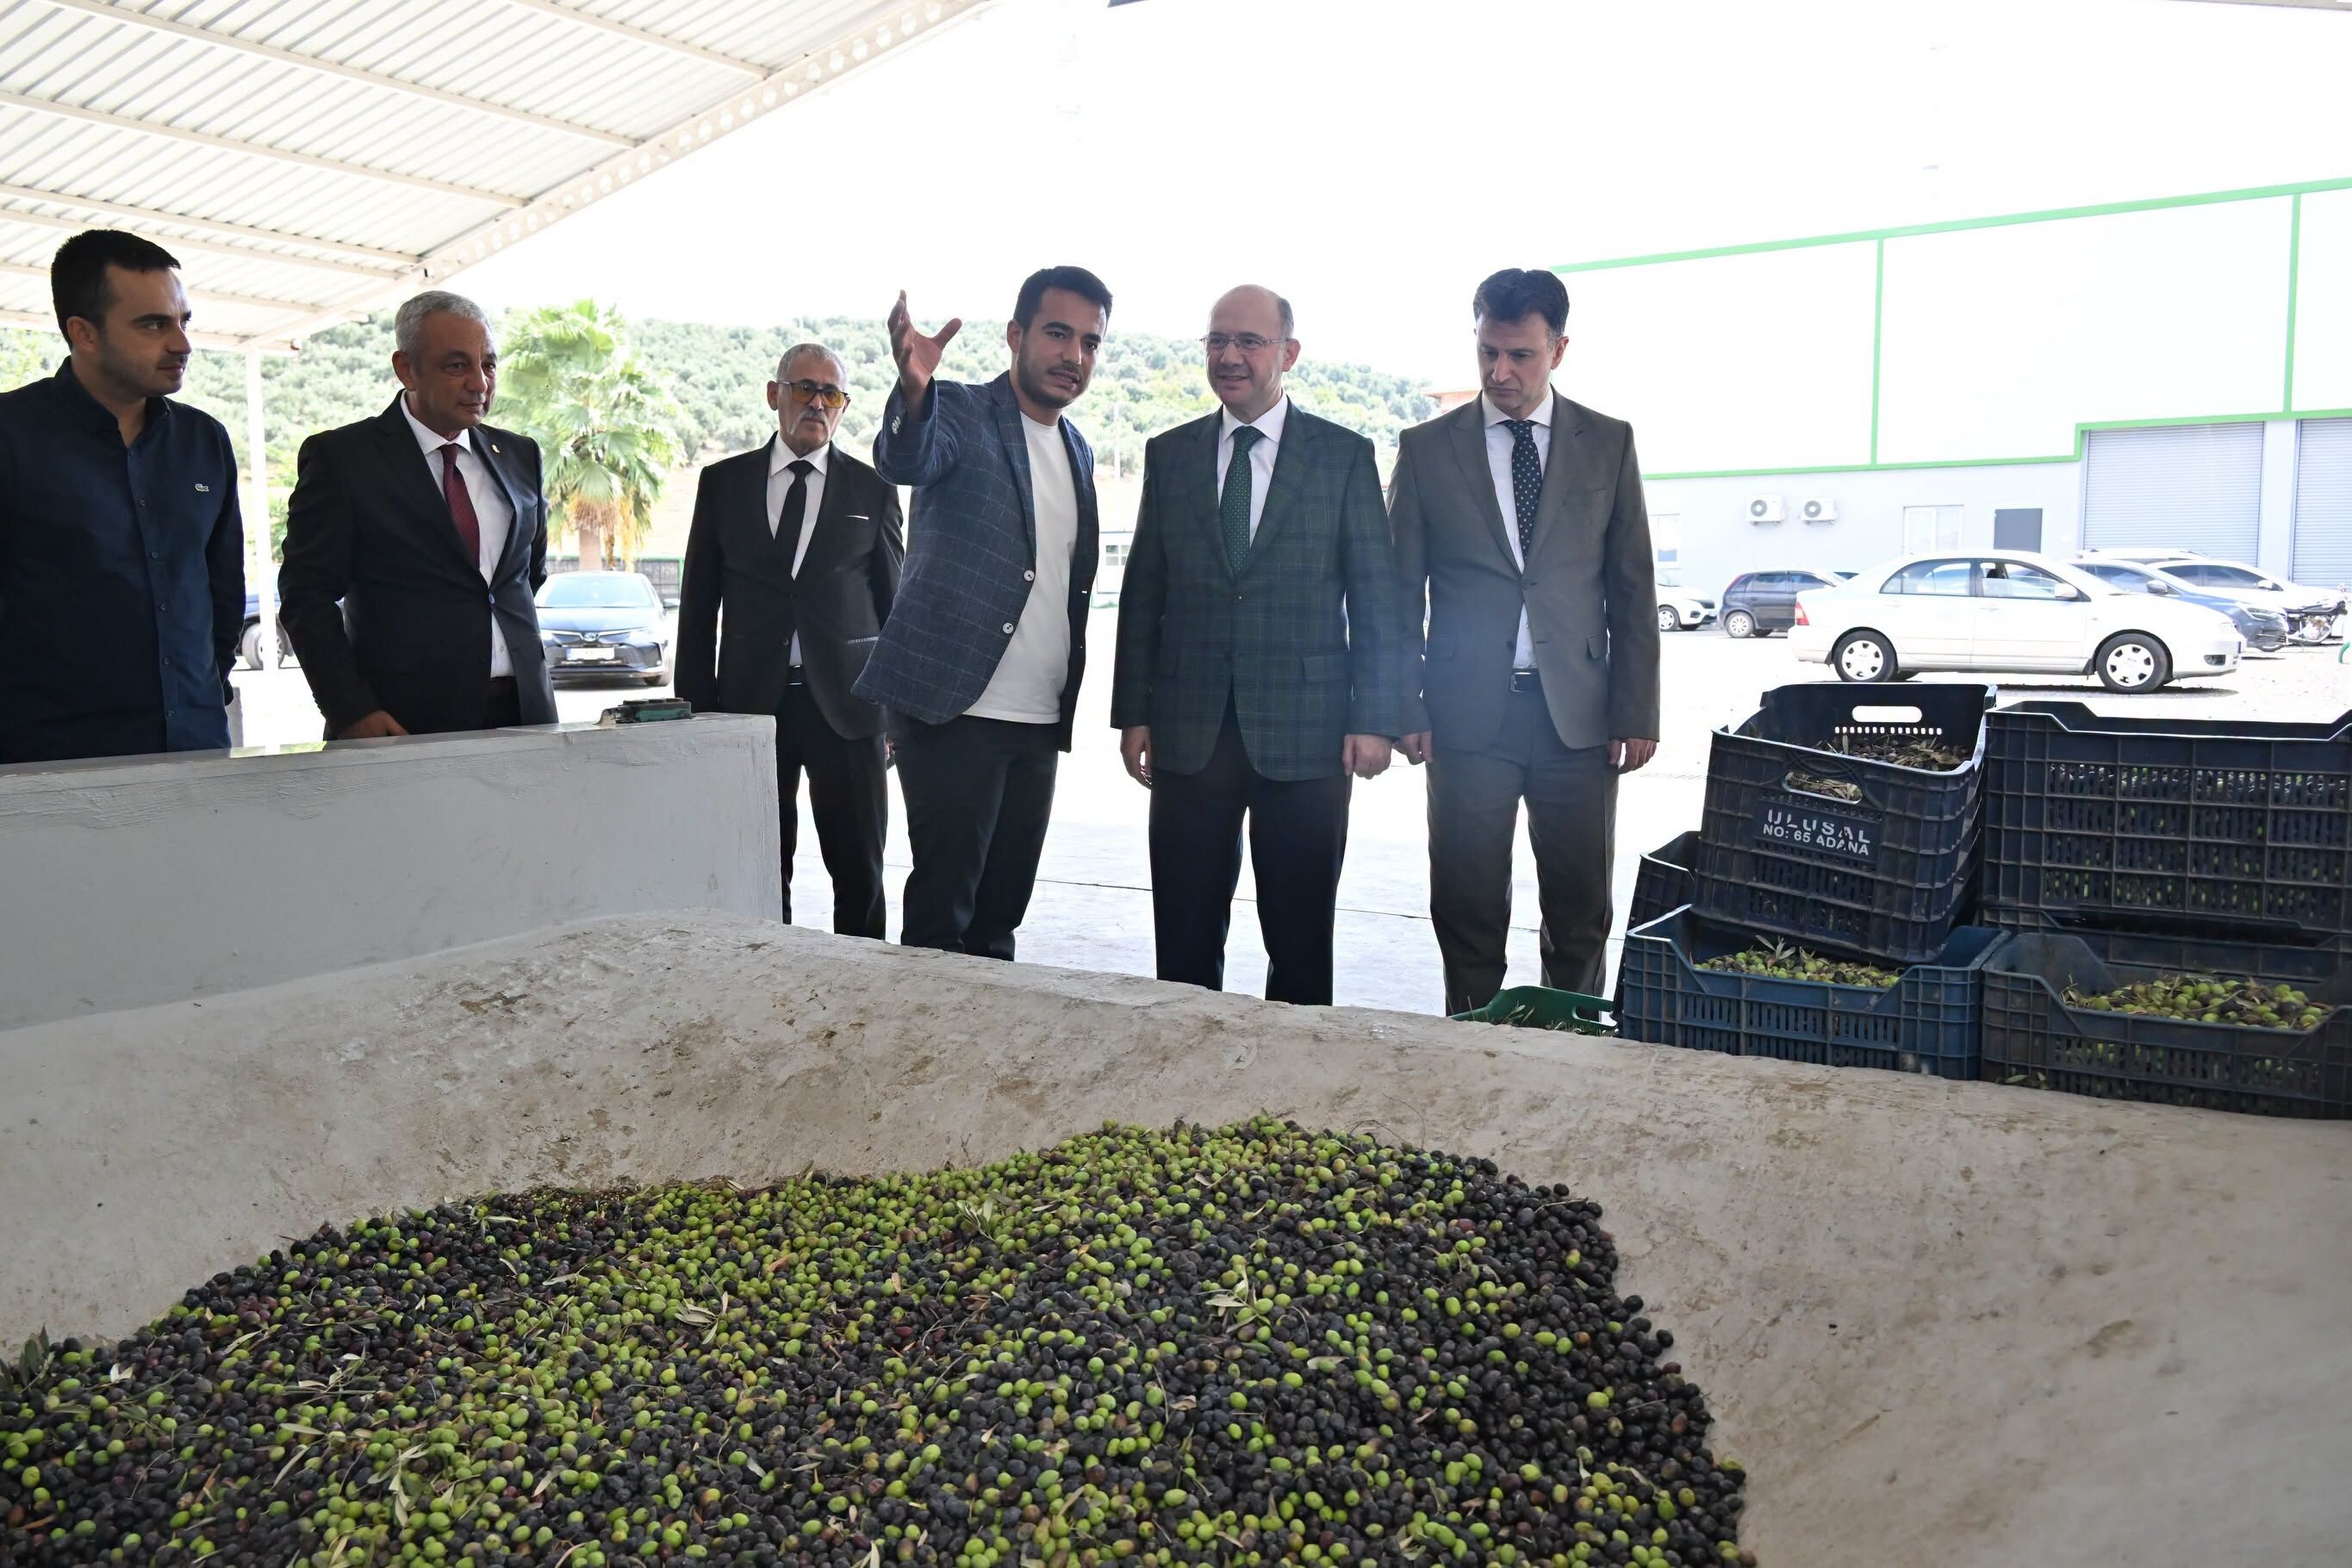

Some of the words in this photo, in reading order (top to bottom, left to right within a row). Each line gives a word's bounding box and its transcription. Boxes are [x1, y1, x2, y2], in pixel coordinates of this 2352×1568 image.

[1763, 824, 1789, 839] NO:
[1794, 831, 1811, 843] 65
[1816, 835, 1870, 856] ADANA
[1768, 809, 1870, 843] ULUSAL
